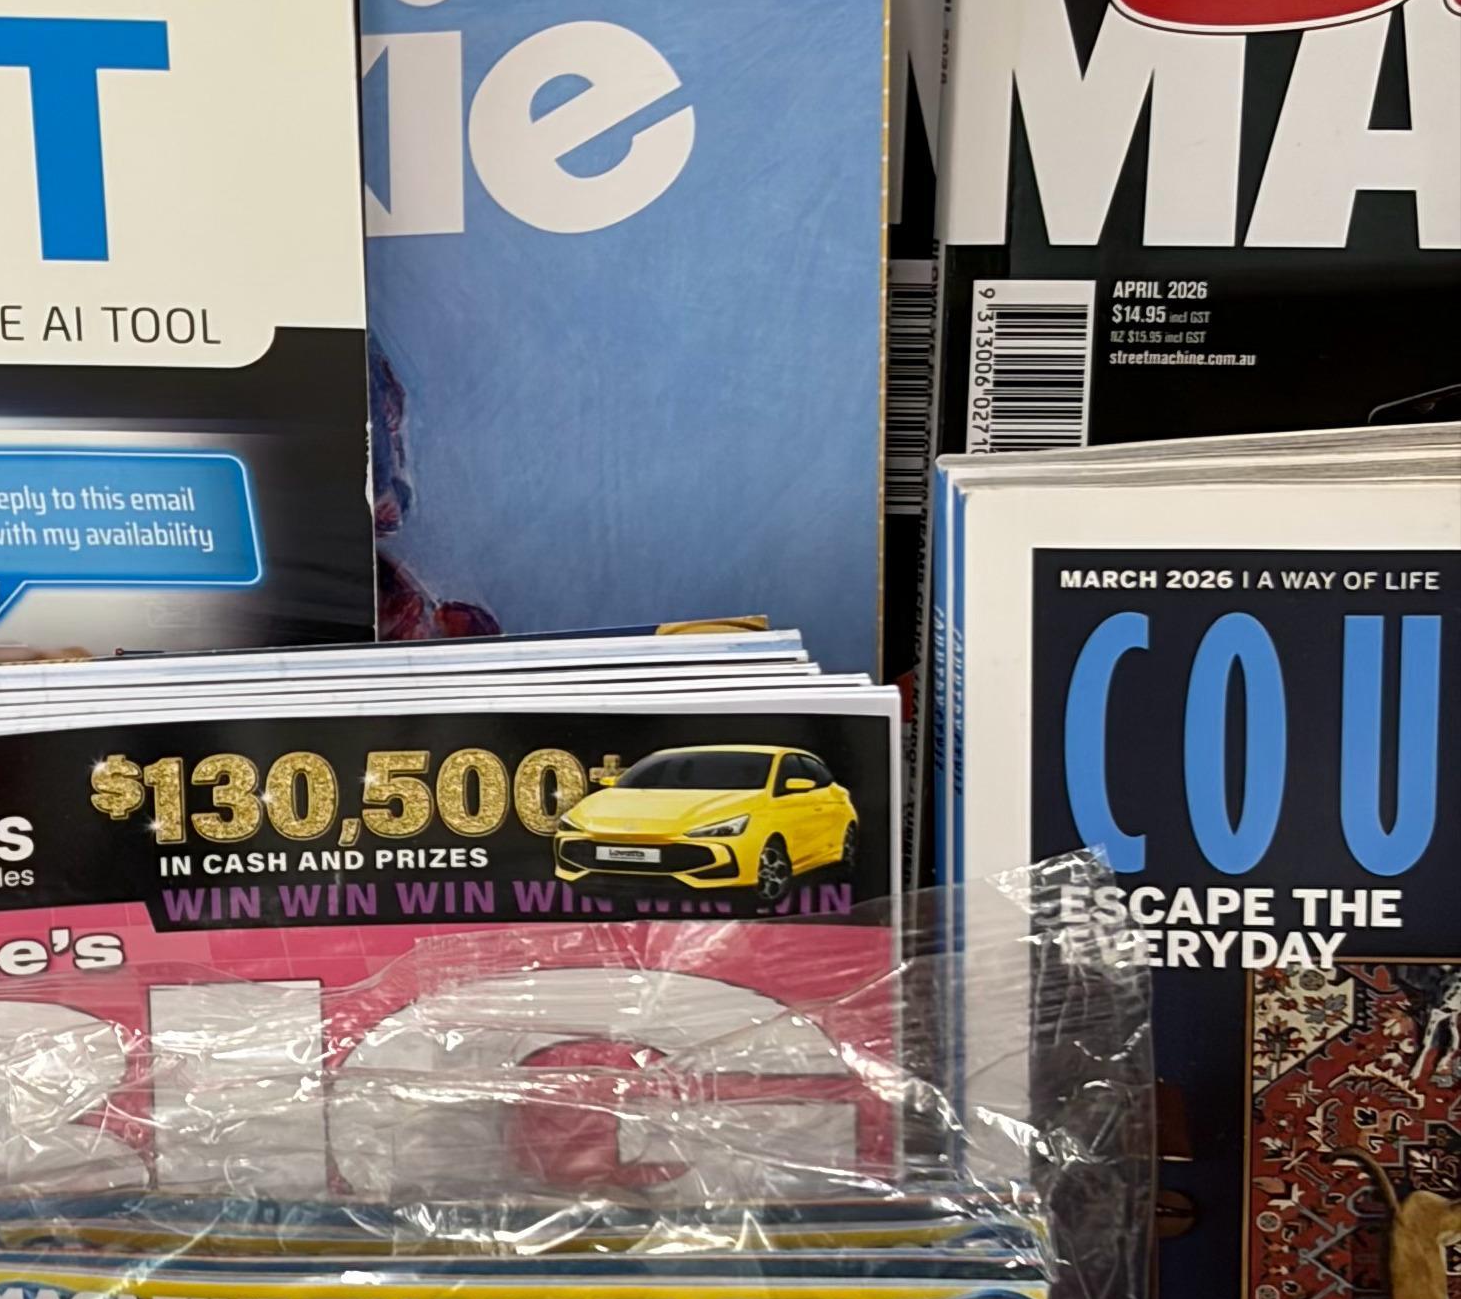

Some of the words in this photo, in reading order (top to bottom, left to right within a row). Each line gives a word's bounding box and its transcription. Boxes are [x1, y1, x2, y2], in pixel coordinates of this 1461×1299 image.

[1112, 280, 1163, 299] APRIL
[1167, 280, 1208, 299] 2026
[42, 306, 83, 343] AI
[101, 306, 222, 345] TOOL
[1111, 303, 1167, 324] $14.95
[1108, 349, 1257, 367] streetmachine.com.au
[51, 488, 76, 512] to
[81, 486, 125, 513] this
[130, 487, 196, 514] email
[42, 529, 81, 551] my
[86, 523, 214, 552] availability
[1059, 569, 1158, 590] MARCH
[1165, 569, 1234, 590] 2026
[1280, 571, 1337, 591] WAY
[1342, 571, 1379, 591] OF
[1385, 571, 1441, 591] LIFE
[160, 855, 191, 877] IN
[201, 851, 288, 875] CASH
[297, 848, 365, 872] AND
[374, 846, 489, 870] PRIZES
[161, 885, 260, 923] WIN
[279, 882, 378, 918] WIN
[394, 880, 496, 915] WIN
[1057, 886, 1274, 928] ESCAPE
[1291, 887, 1404, 929] THE
